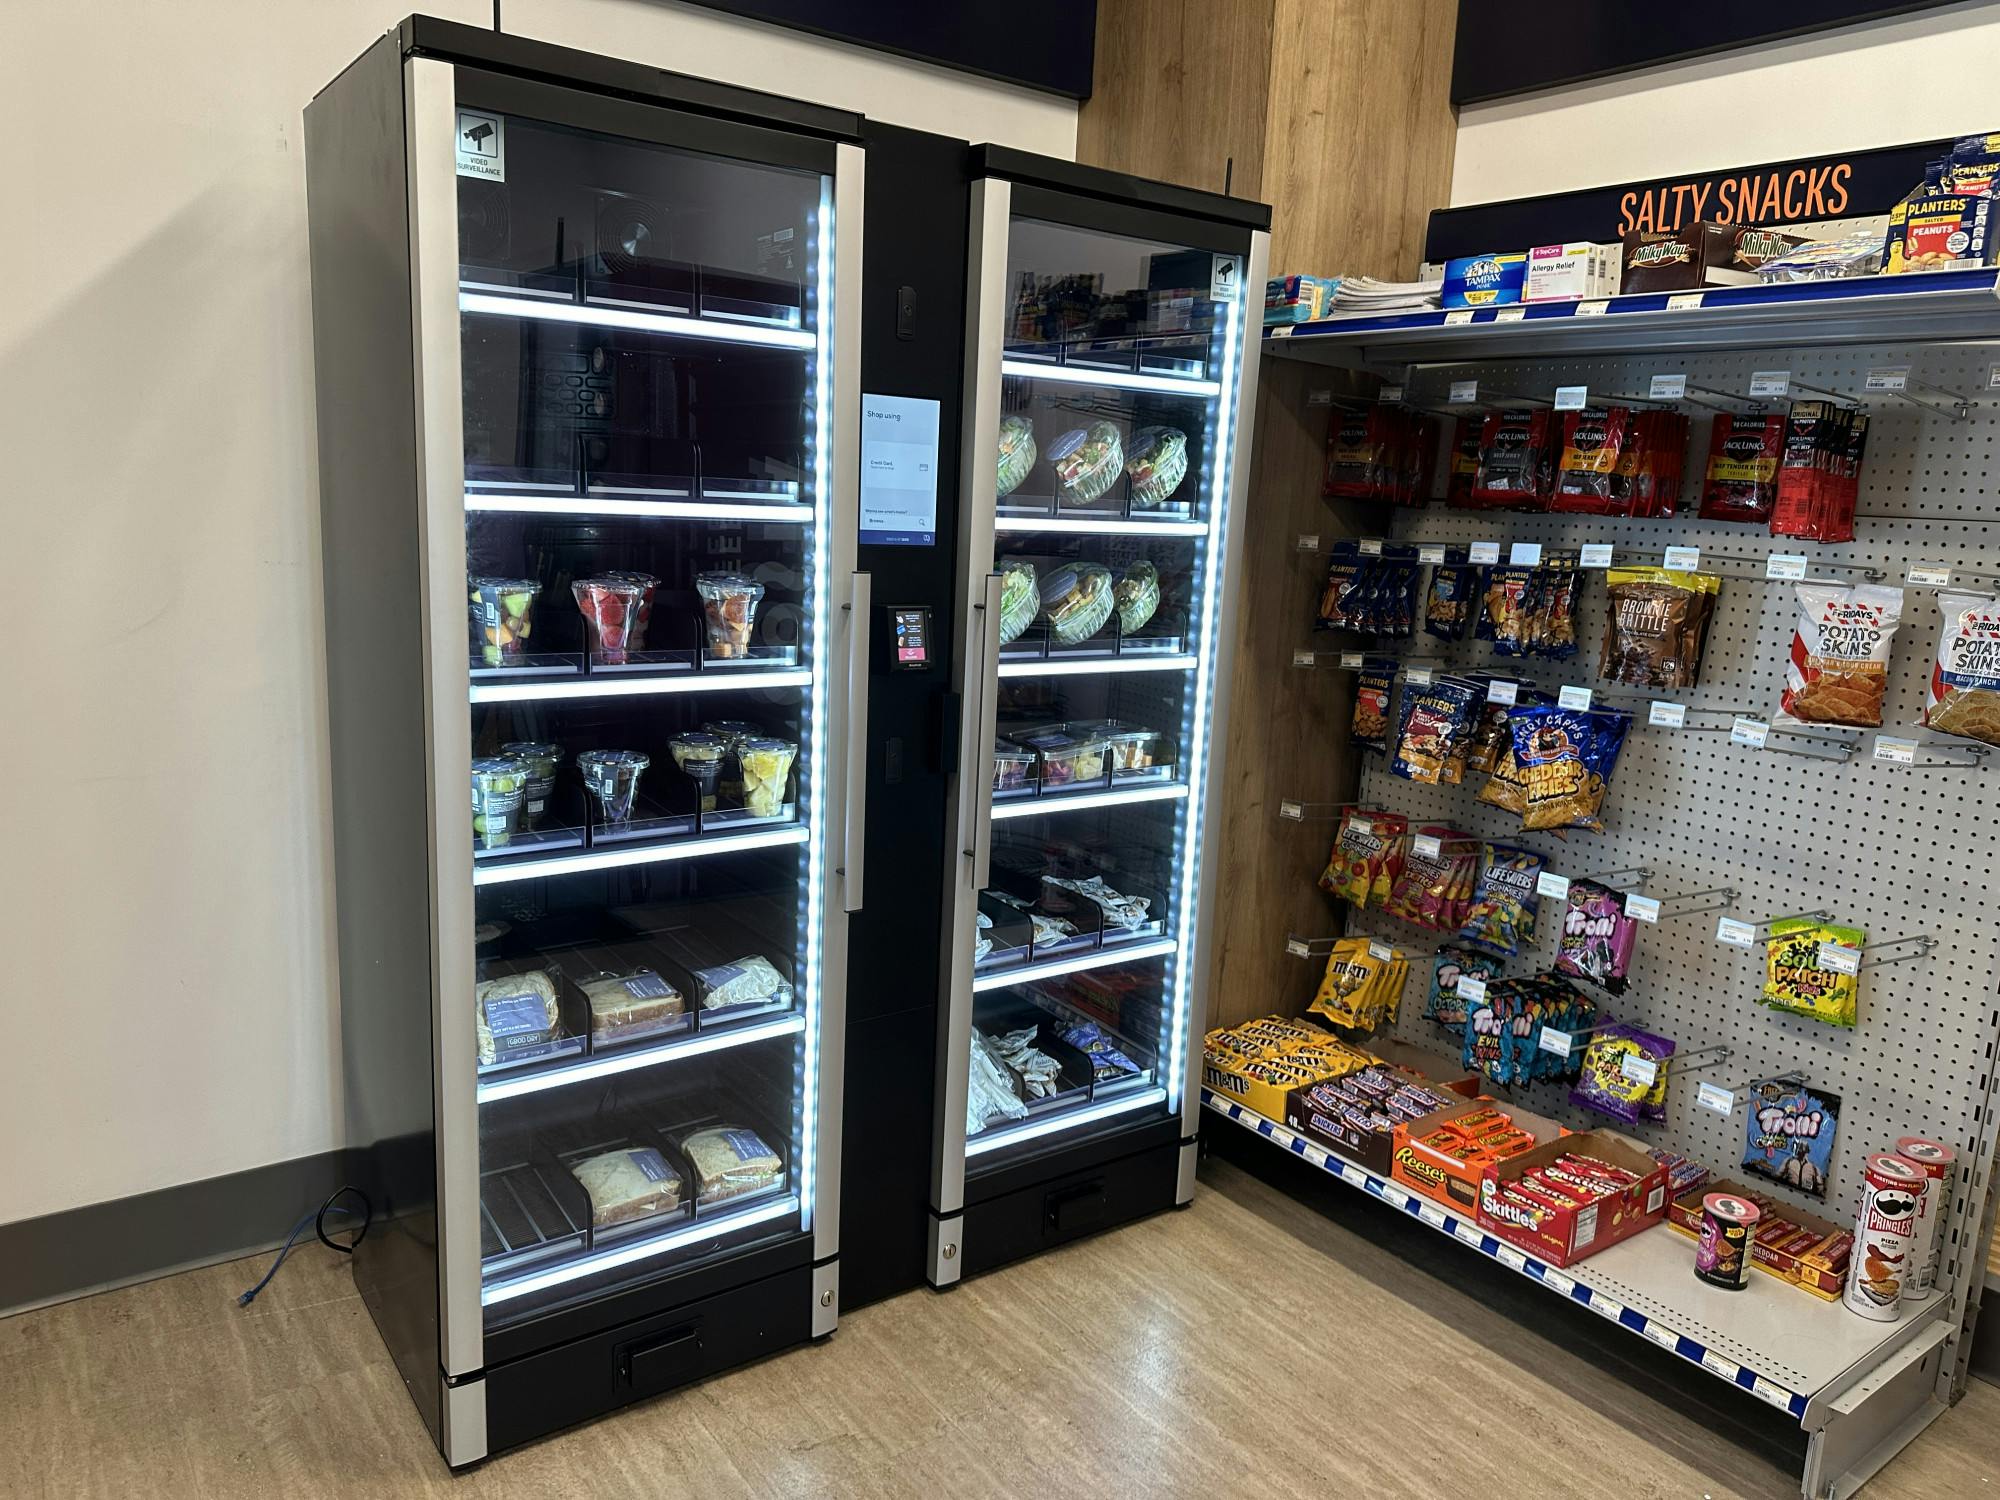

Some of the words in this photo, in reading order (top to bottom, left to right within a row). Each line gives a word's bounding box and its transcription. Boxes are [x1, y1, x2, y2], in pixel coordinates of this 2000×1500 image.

[457, 163, 501, 176] SURVEILLANCE
[470, 158, 488, 166] VIDEO
[1618, 182, 1712, 237] SALTY
[1716, 163, 1852, 226] SNACKS
[1907, 198, 1967, 217] PLANTERS
[1913, 225, 1954, 236] PEANUTS
[1531, 263, 1555, 273] Allergy
[1556, 261, 1576, 270] Relief
[1465, 273, 1501, 288] TAMPAX
[867, 411, 884, 420] Shop
[885, 413, 901, 421] using
[1572, 431, 1587, 440] JACK
[1722, 441, 1741, 450] JACK
[1505, 571, 1529, 580] PLANTERS
[1622, 599, 1673, 617] BROWNIE
[1619, 612, 1670, 632] BRITTLE
[1818, 623, 1881, 642] POTATO
[1820, 638, 1872, 656] SKINS
[1860, 661, 1882, 670] CREAM
[1358, 676, 1389, 689] PLANTERS
[1974, 676, 1997, 687] RANCH
[1527, 778, 1578, 801] FRIES
[1341, 840, 1373, 859] GUMMIES
[1407, 859, 1442, 880] GUMMIES
[1486, 881, 1524, 900] GUMMIES
[1776, 965, 1838, 989] PATCH
[1477, 1035, 1499, 1047] EVIL
[1312, 1114, 1343, 1137] SNICKERS
[1873, 1173, 1897, 1186] BURSTING
[1482, 1196, 1539, 1232] Skittles
[1869, 1210, 1912, 1236] PRINGLES
[1881, 1237, 1899, 1245] PIZZA
